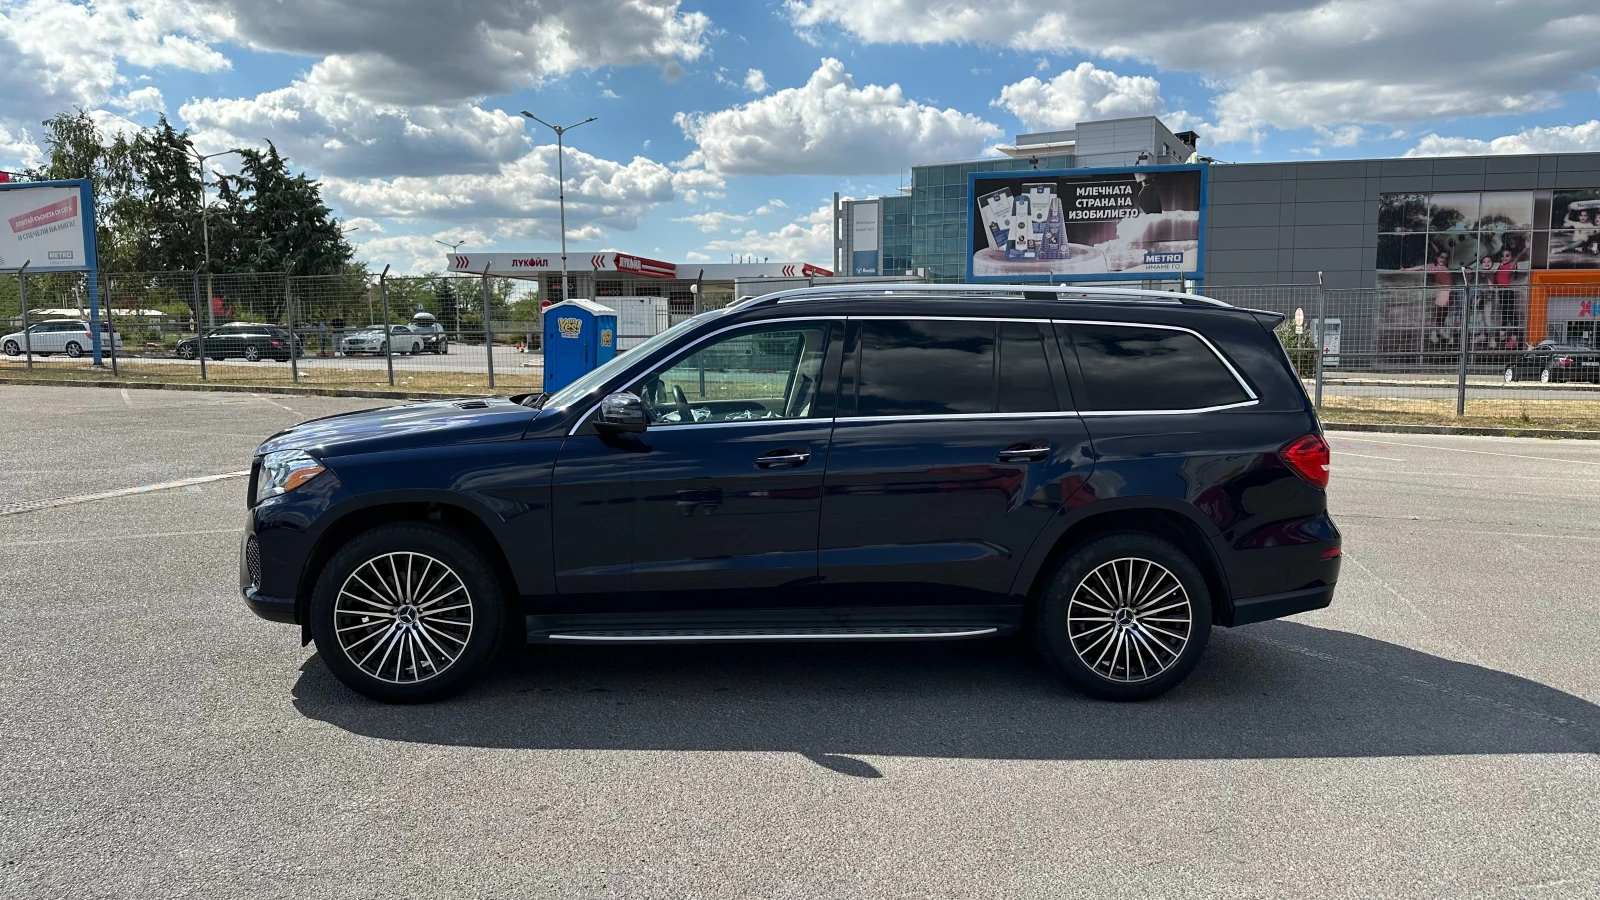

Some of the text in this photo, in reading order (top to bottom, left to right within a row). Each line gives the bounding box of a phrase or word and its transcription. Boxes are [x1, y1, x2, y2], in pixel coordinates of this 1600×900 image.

[1076, 185, 1132, 196] МЛЕЧНАТА
[1075, 197, 1132, 207] СТРАНА НА
[15, 217, 34, 228] ОПИТАЙ
[61, 205, 73, 214] СЕГА
[1068, 208, 1139, 219] ИЗОБИЛИЕТО
[22, 228, 49, 240] СПЕЧЕЛИ
[49, 225, 57, 233] НА
[511, 257, 549, 267] ЛУКОЙЛ
[1145, 254, 1181, 263] METRO
